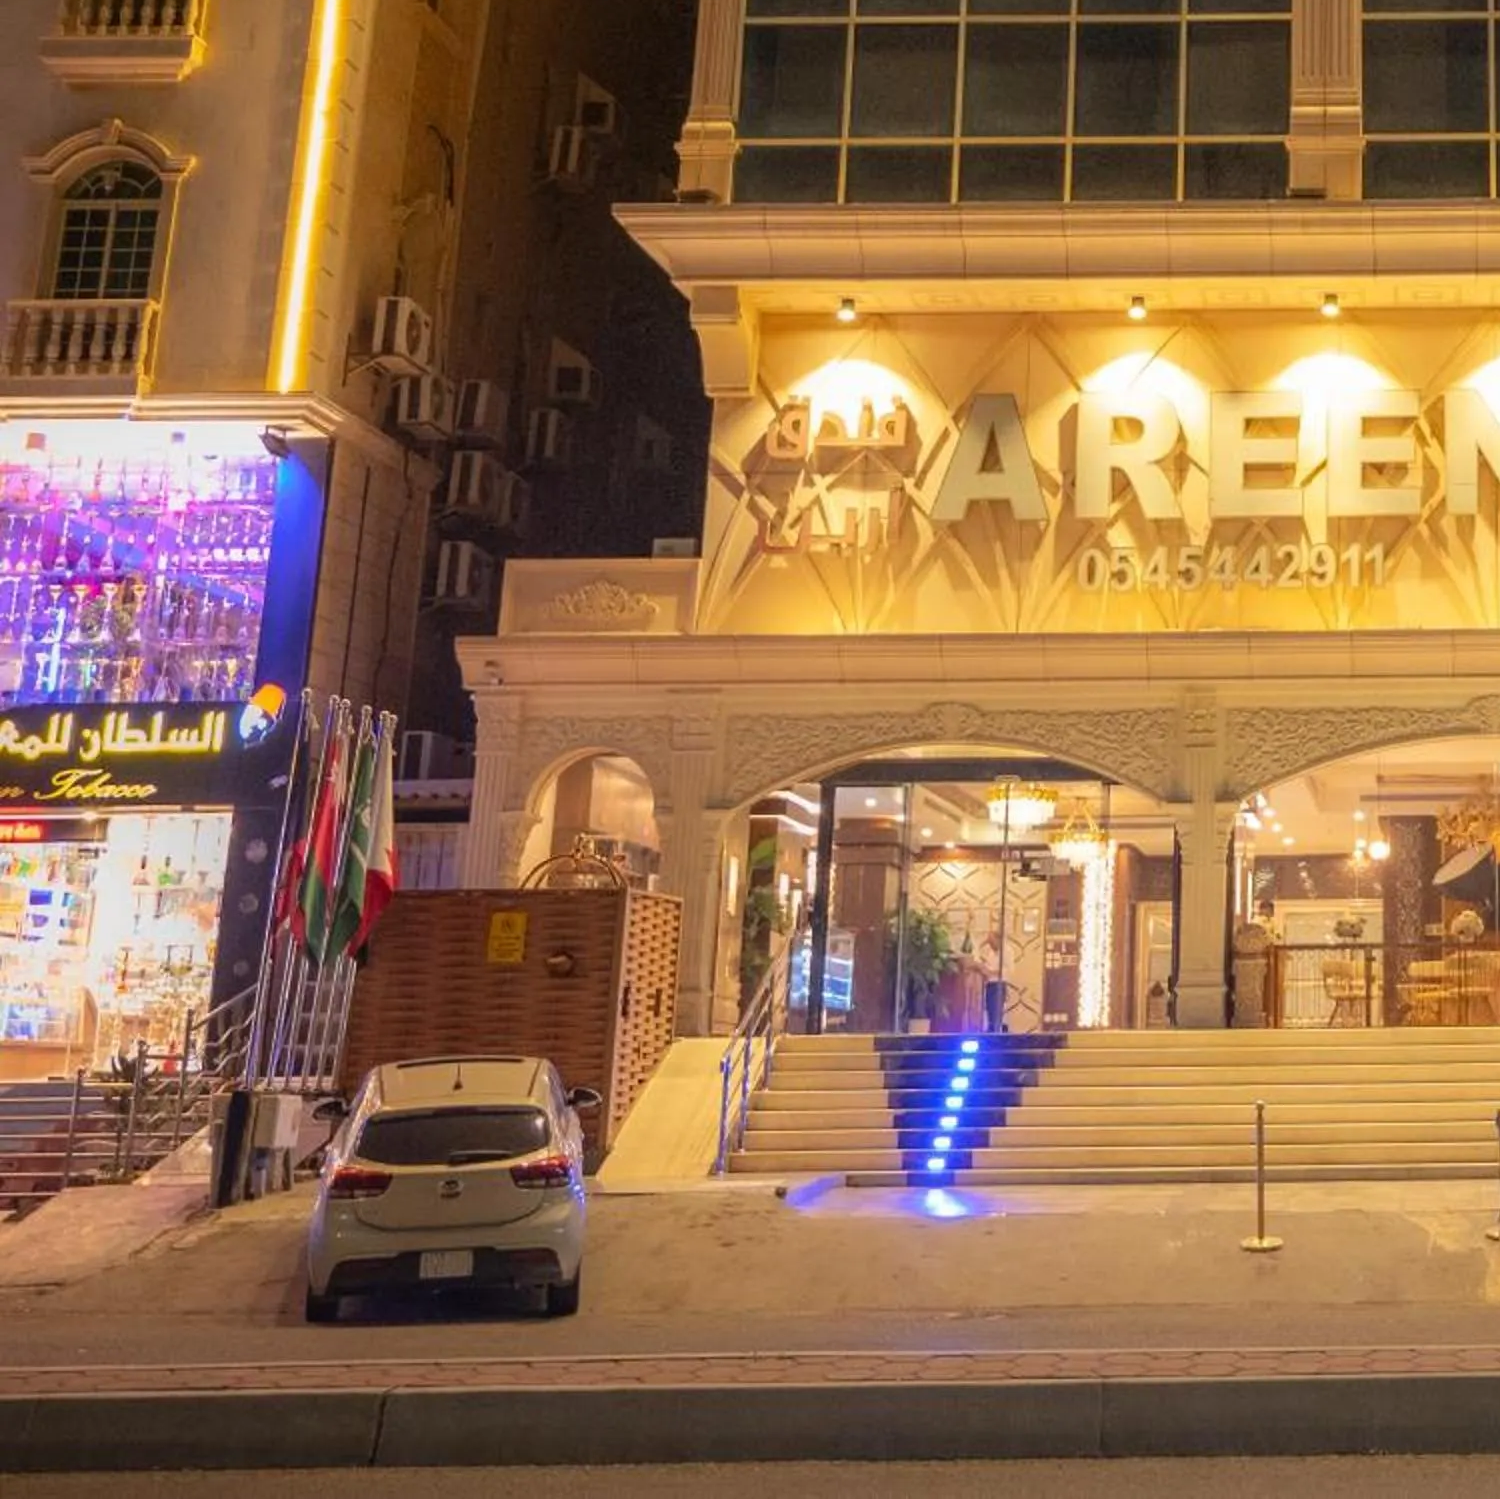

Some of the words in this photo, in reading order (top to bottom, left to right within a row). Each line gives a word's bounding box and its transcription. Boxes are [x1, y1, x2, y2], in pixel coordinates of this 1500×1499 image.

[765, 393, 908, 460] فندق
[1078, 543, 1386, 593] 0545442911
[79, 710, 226, 762] السلطان
[33, 768, 157, 800] Tobacco
